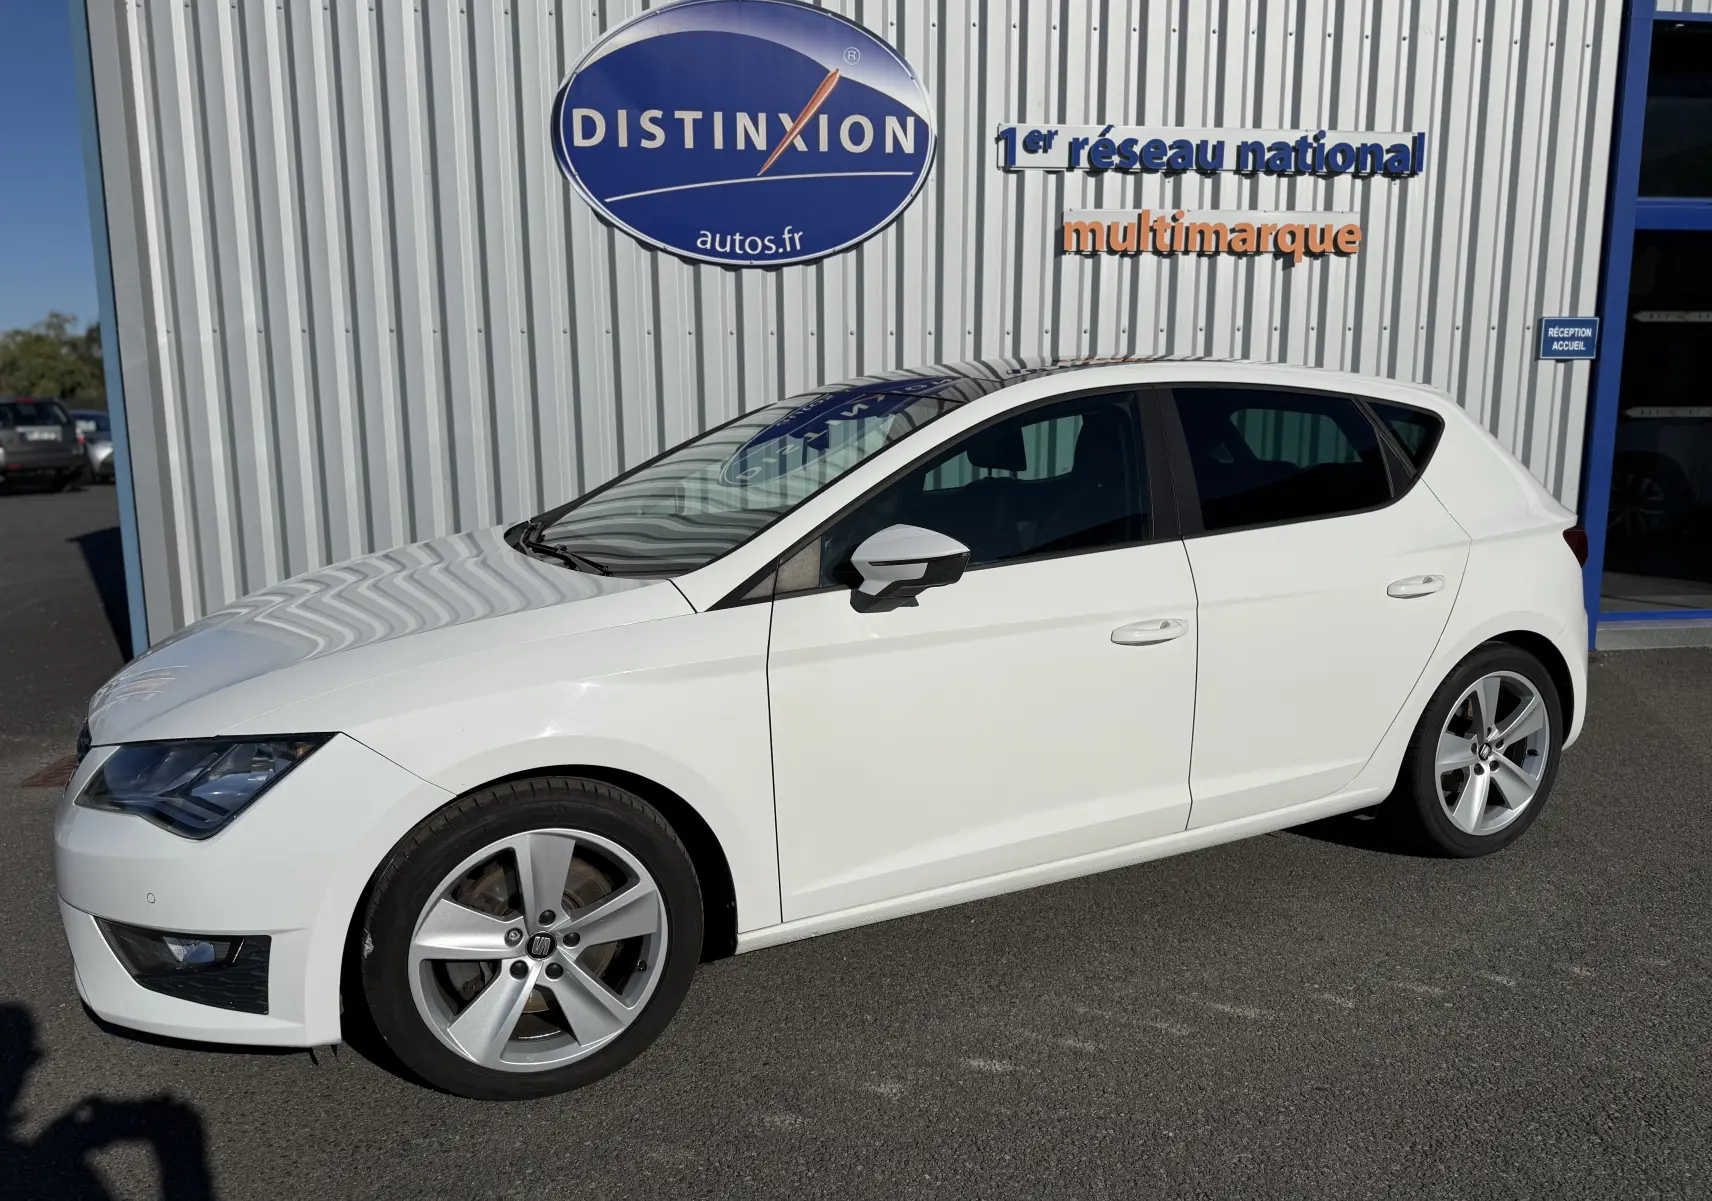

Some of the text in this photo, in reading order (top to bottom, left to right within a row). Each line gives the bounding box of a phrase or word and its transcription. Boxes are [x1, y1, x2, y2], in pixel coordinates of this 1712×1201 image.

[1000, 124, 1426, 174] 1er réseau national
[696, 225, 803, 255] autos.fr
[1063, 209, 1362, 263] multimarque
[1548, 325, 1592, 337] RÉCEPTION
[1552, 341, 1586, 350] ACCUEIL
